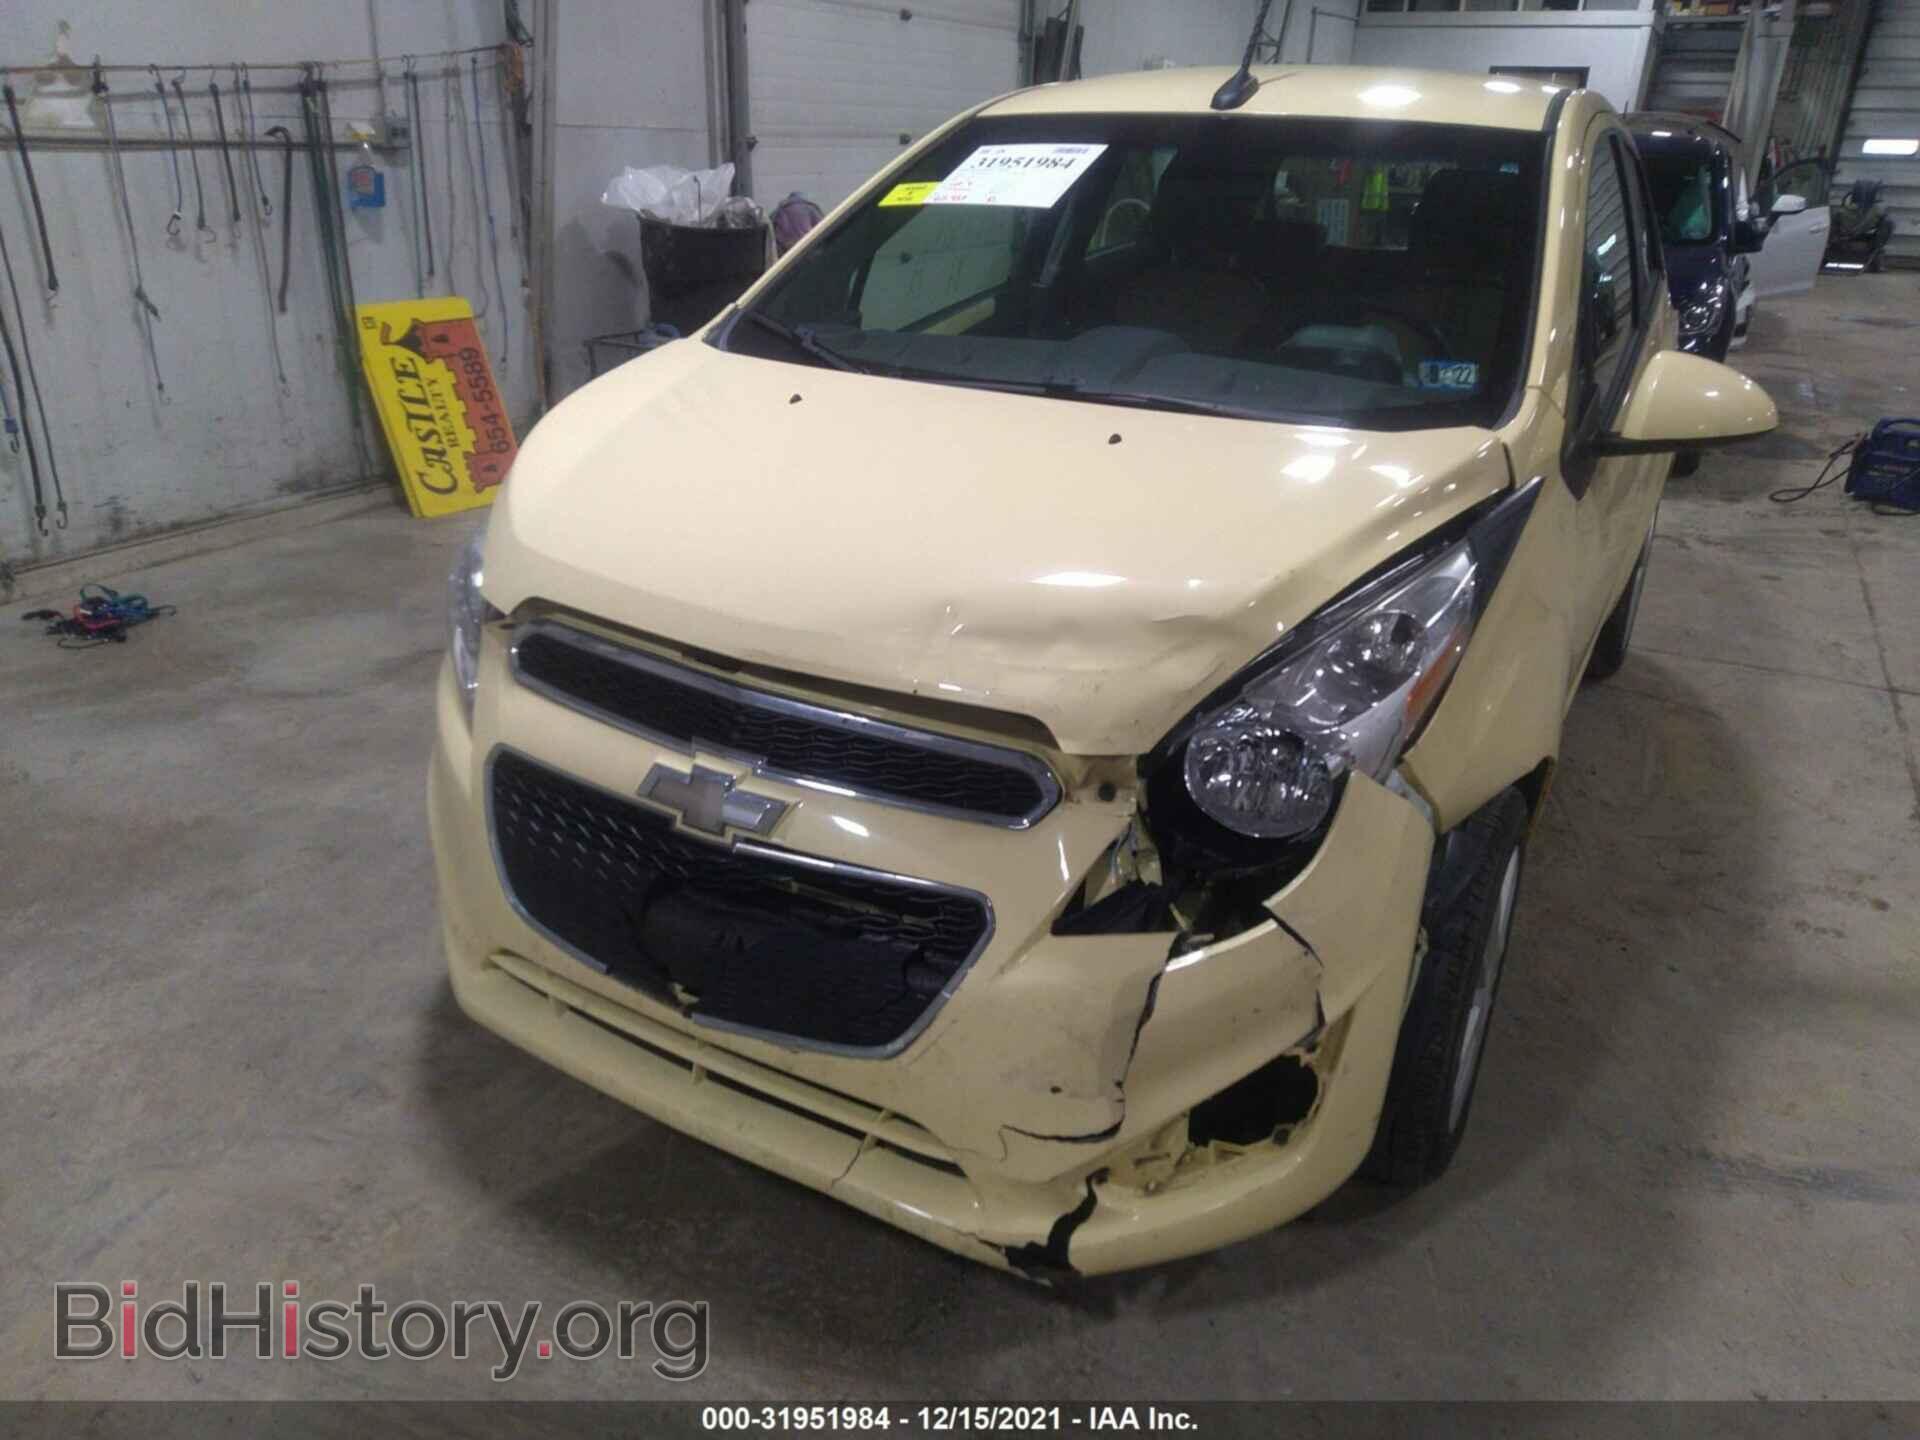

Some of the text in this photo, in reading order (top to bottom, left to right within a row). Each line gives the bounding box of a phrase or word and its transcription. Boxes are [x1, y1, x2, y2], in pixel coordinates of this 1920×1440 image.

[391, 356, 459, 495] CASTLE
[426, 377, 460, 449] REALTY
[457, 347, 511, 455] 654-5589
